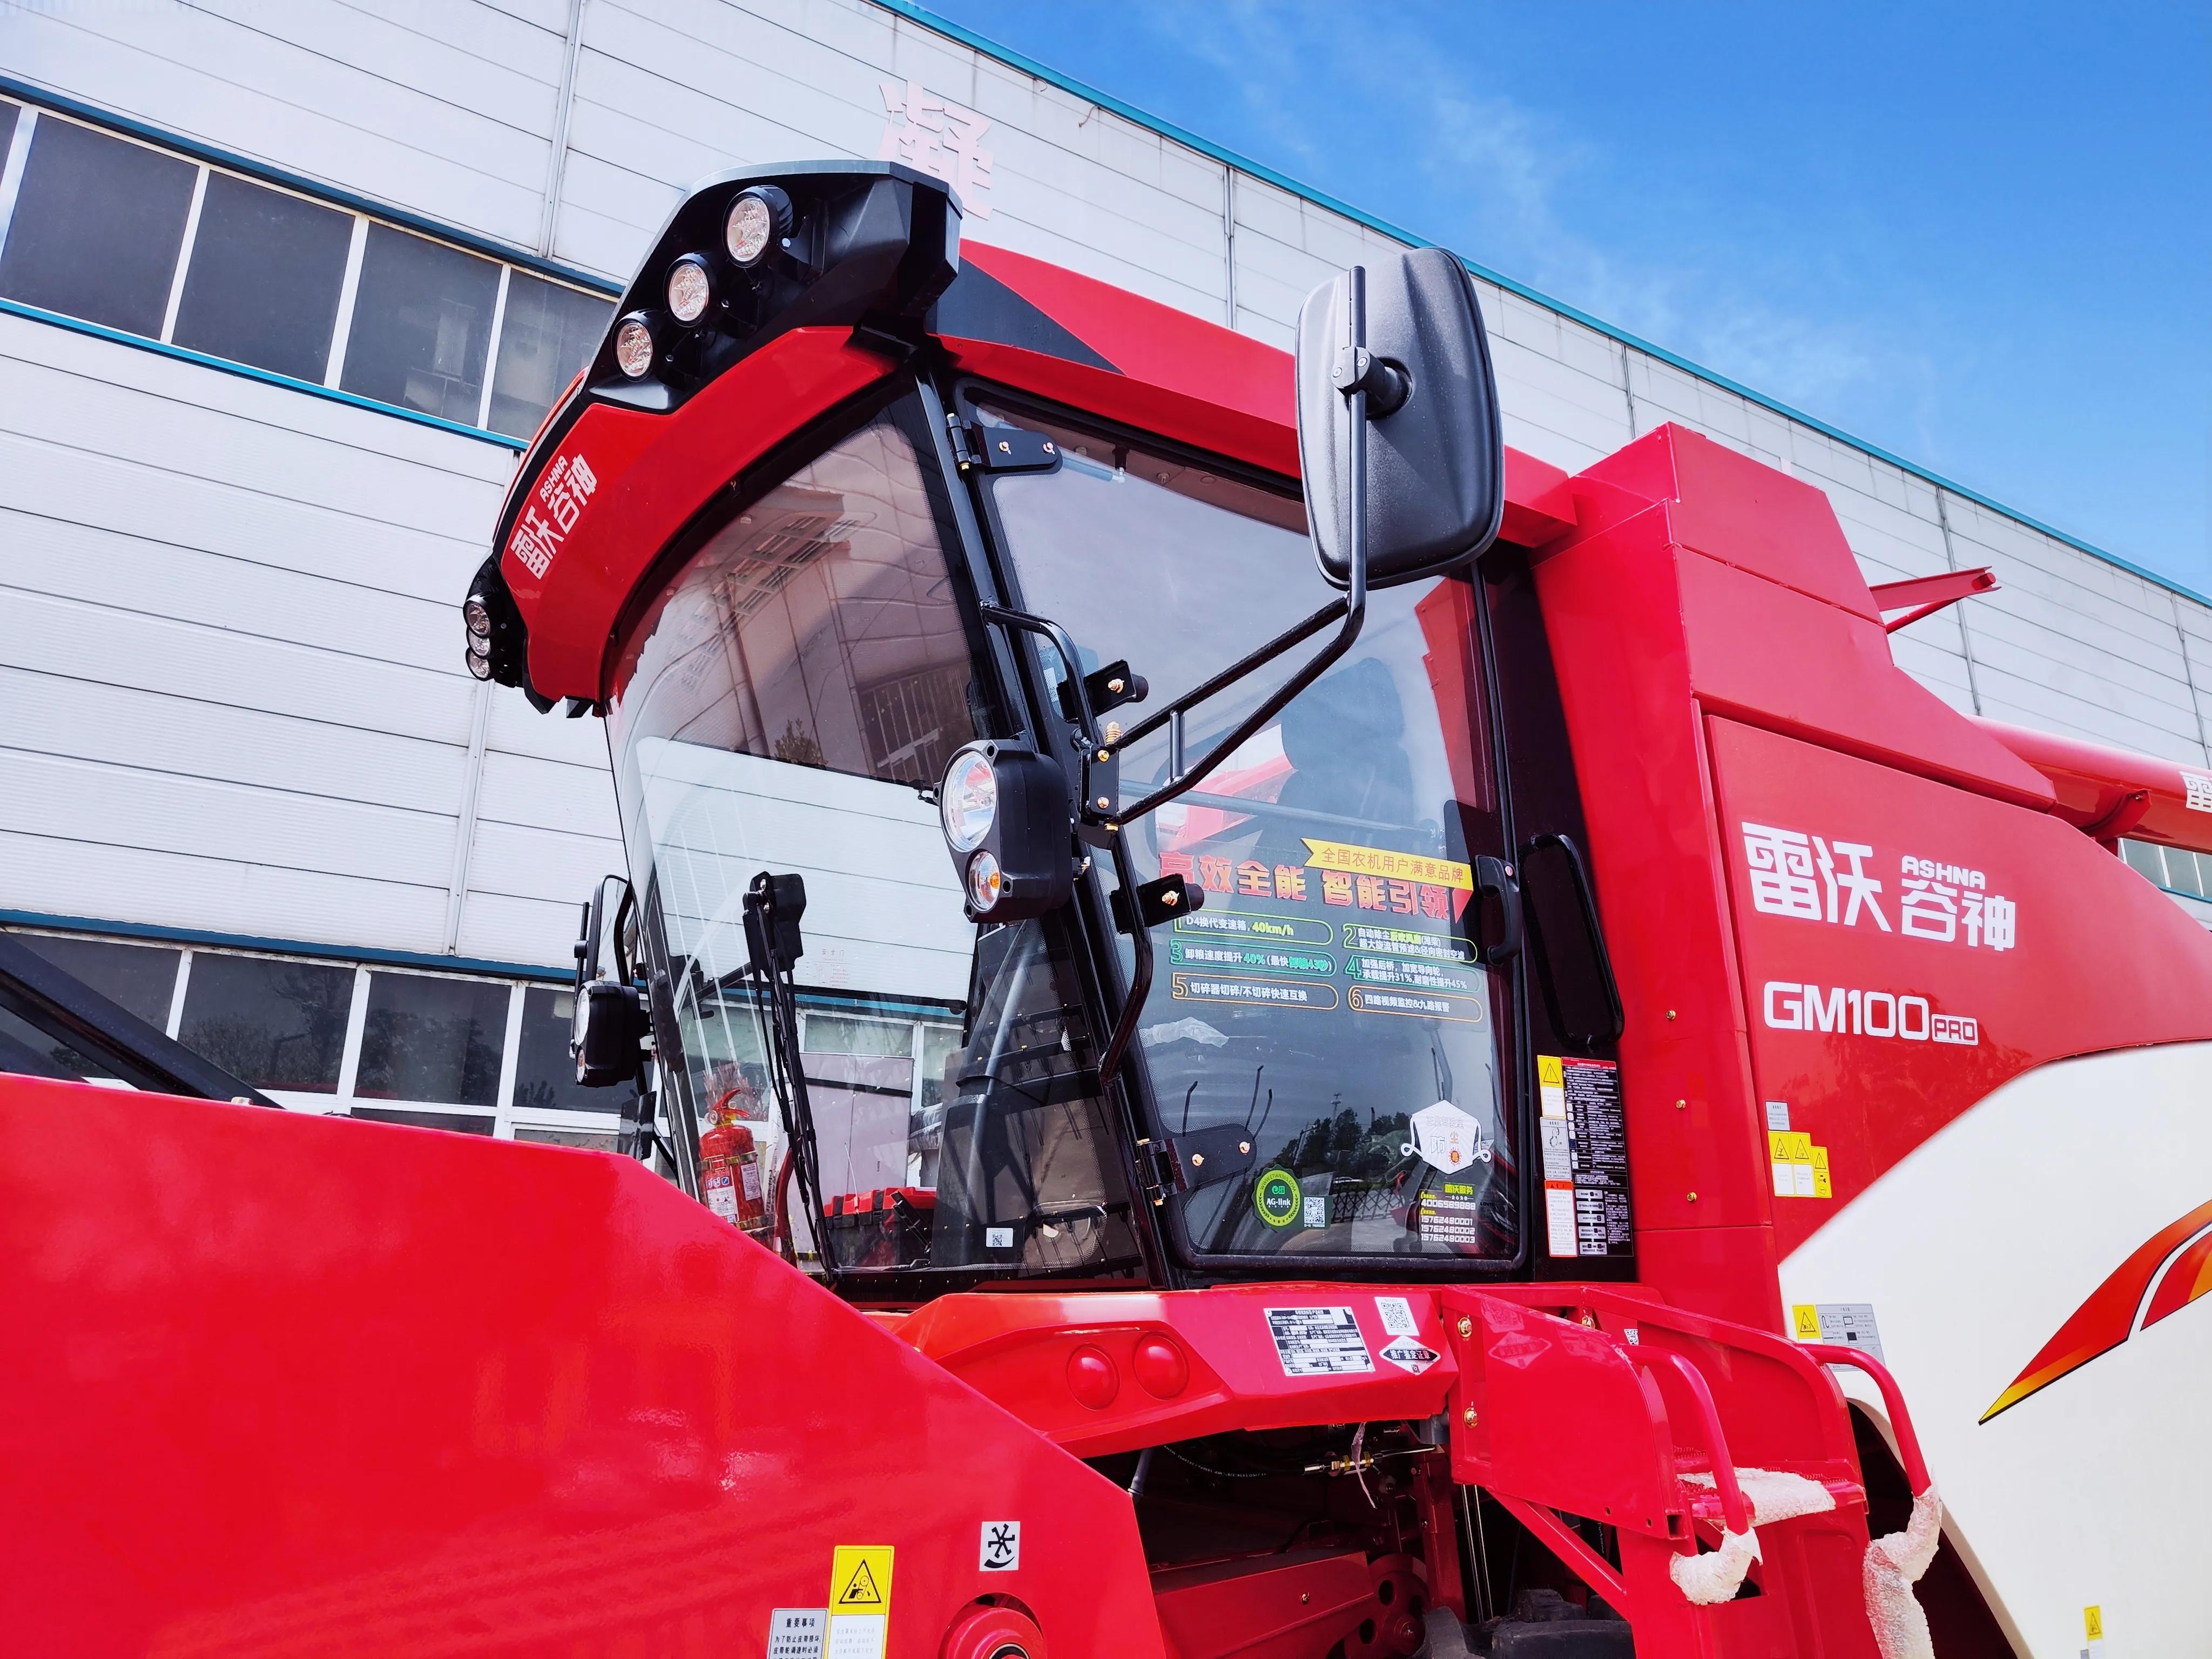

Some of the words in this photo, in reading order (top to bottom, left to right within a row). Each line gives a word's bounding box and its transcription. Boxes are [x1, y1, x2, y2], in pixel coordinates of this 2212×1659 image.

[540, 455, 568, 502] ASHNA
[510, 505, 564, 580] 雷沃
[547, 454, 597, 534] 谷神
[1321, 847, 1464, 884] 全国农机用户满意品牌
[1901, 855, 1985, 889] ASHNA
[1158, 852, 1307, 901] 高效全能
[1321, 870, 1451, 921] 智能引领
[1742, 821, 1892, 932] 雷沃
[1901, 878, 2016, 952] 谷神
[1252, 921, 1294, 936] 40km/h
[1190, 981, 1307, 1002] 切碎器切碎/不切碎快速互换
[1764, 981, 1930, 1041] GM100
[1933, 1017, 1977, 1042] PRO
[1445, 1184, 1473, 1195] 雷沃服务
[1421, 1215, 1473, 1225] 15762480001
[1421, 1224, 1475, 1235] 15762480002
[1421, 1233, 1475, 1244] 15762480003
[786, 1618, 815, 1628] 重要事项
